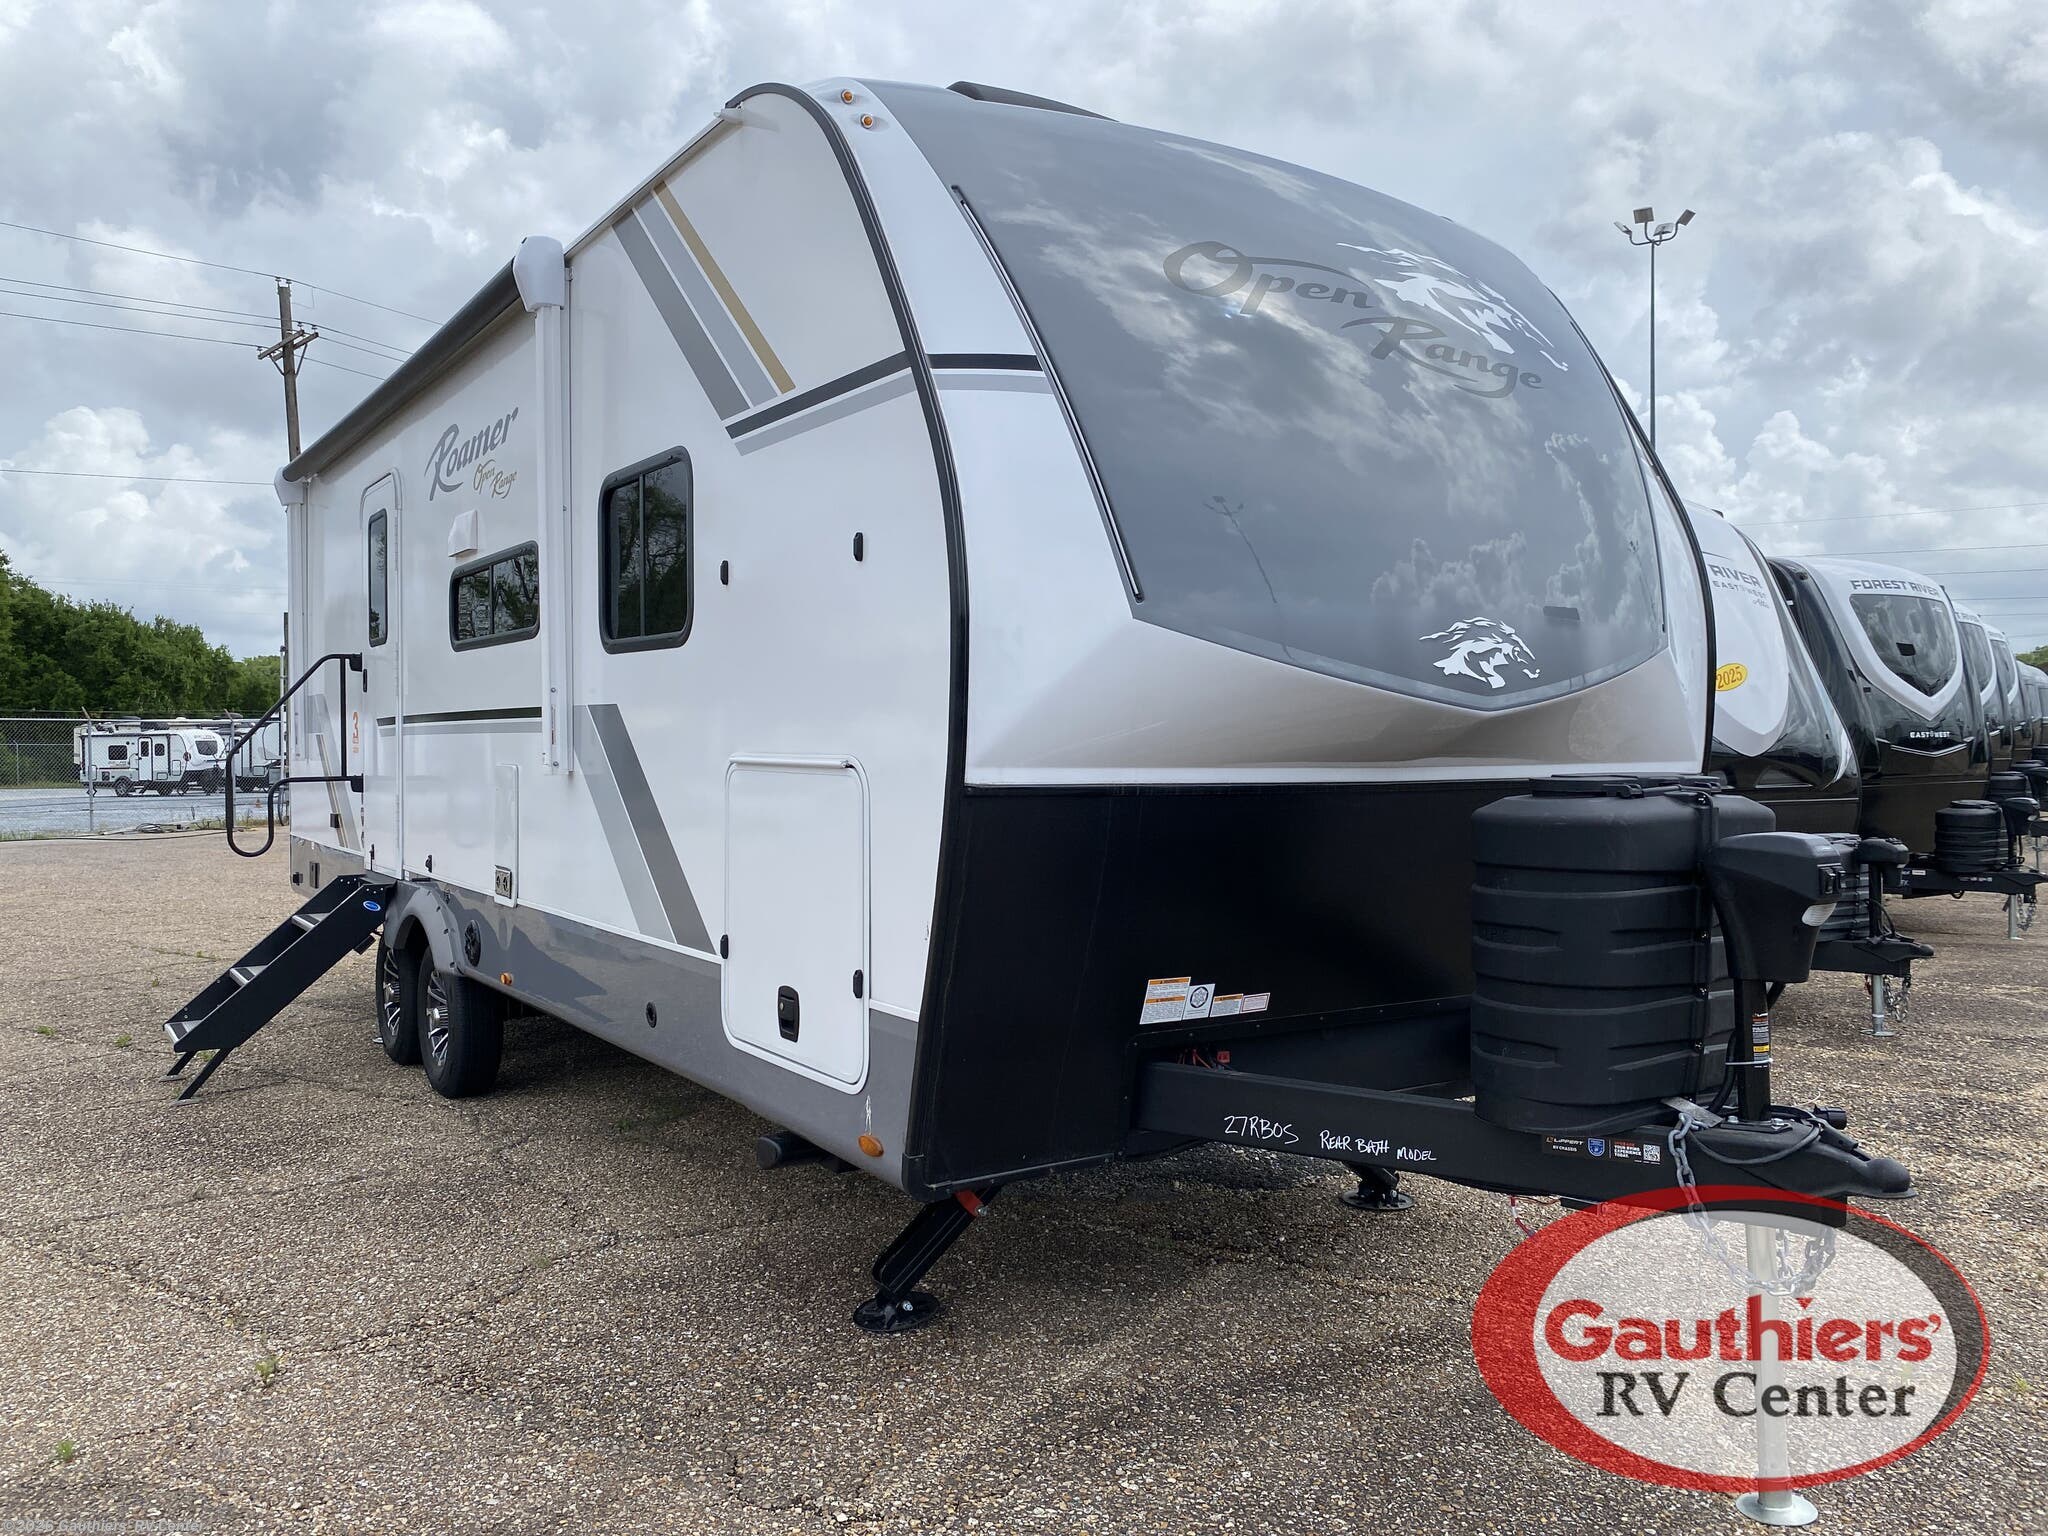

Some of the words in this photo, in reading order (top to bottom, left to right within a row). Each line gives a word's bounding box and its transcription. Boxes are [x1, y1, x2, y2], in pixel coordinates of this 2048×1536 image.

[1163, 241, 1376, 315] Open
[1341, 316, 1545, 399] Range
[424, 406, 519, 501] Roamer
[473, 458, 496, 495] Open
[490, 470, 517, 499] Range
[1707, 564, 1763, 589] RIVER
[1850, 579, 1907, 591] FOREST
[1908, 581, 1940, 596] RIVER
[1717, 665, 1743, 690] 2025
[1319, 1129, 1353, 1152] REAR
[1355, 1138, 1391, 1157] BATH
[1397, 1146, 1438, 1162] MODEL
